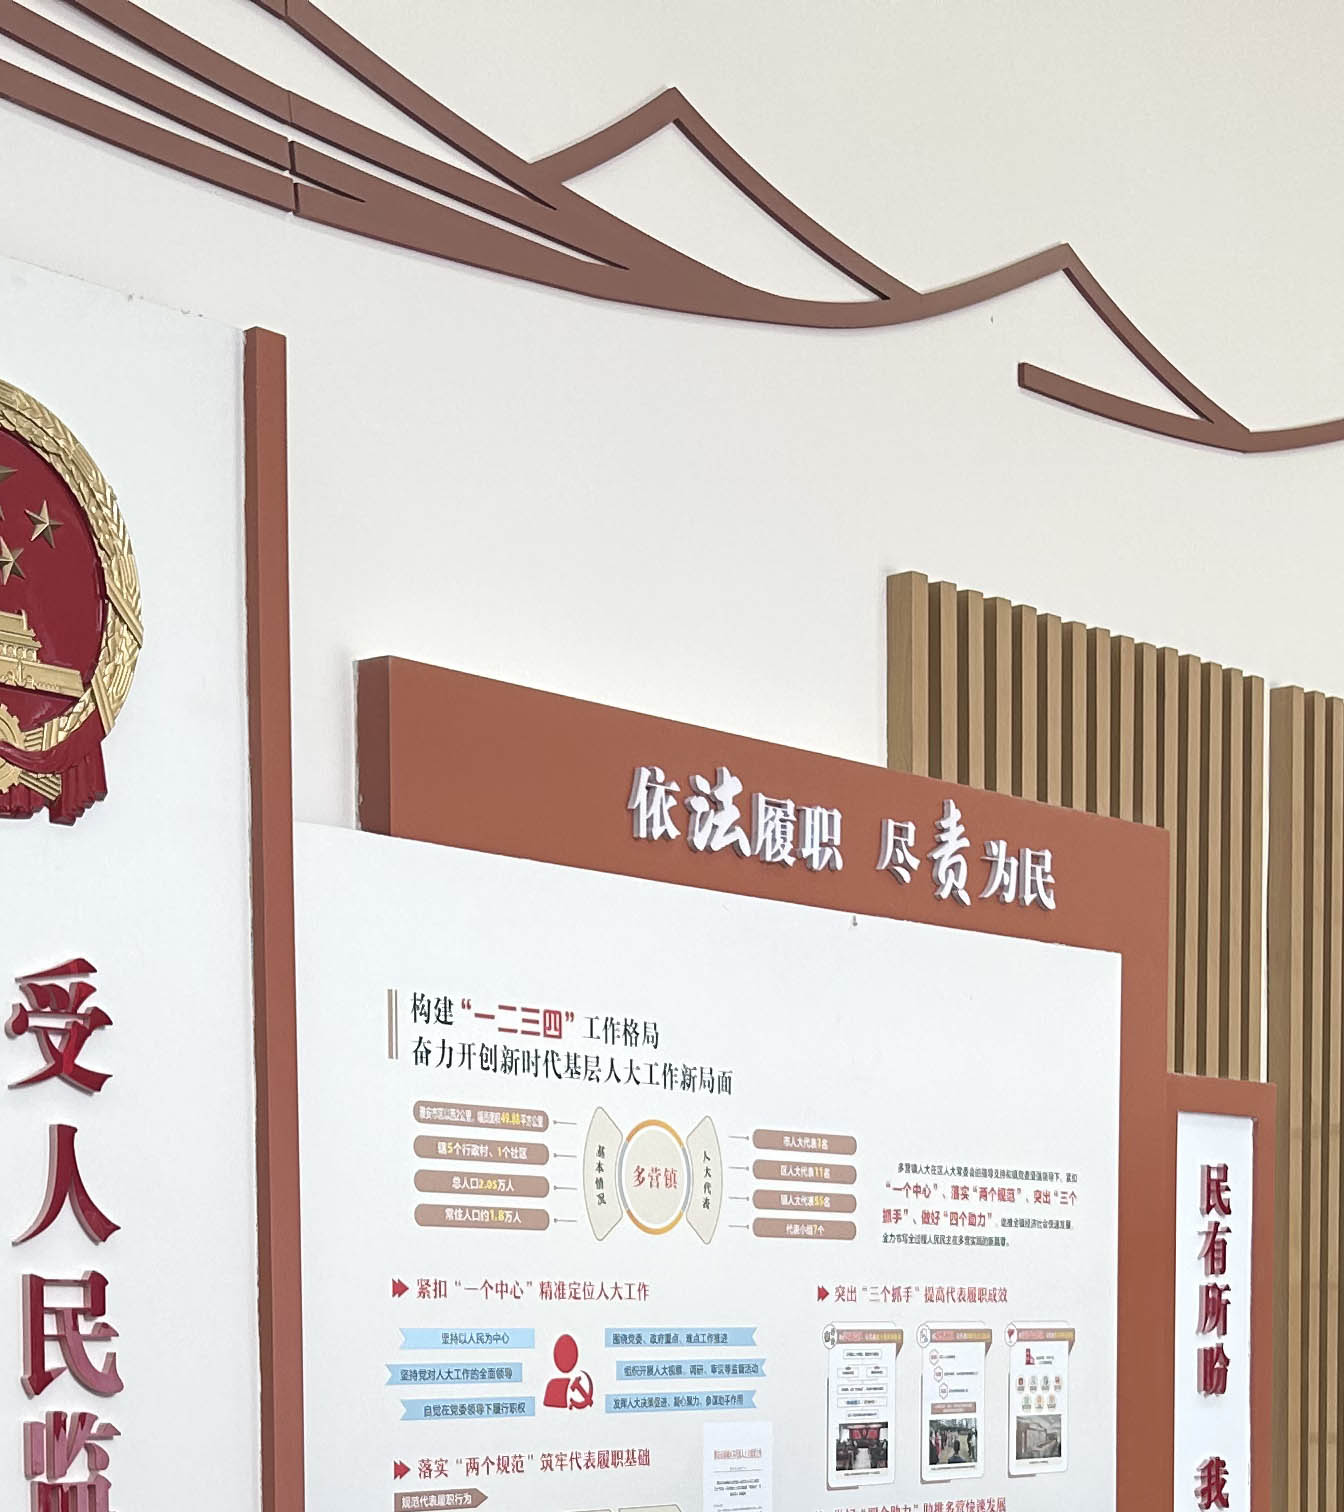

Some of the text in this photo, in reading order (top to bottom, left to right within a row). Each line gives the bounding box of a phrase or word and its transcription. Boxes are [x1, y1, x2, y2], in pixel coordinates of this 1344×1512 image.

[627, 766, 1056, 910] 依法履职 尽责为民
[413, 1036, 733, 1095] 奋力开创新时代基层人大工作新局面
[632, 1165, 678, 1189] 多营镇
[1197, 1163, 1232, 1397] 民有所盼
[441, 1332, 510, 1345] 坚持以人民为中心
